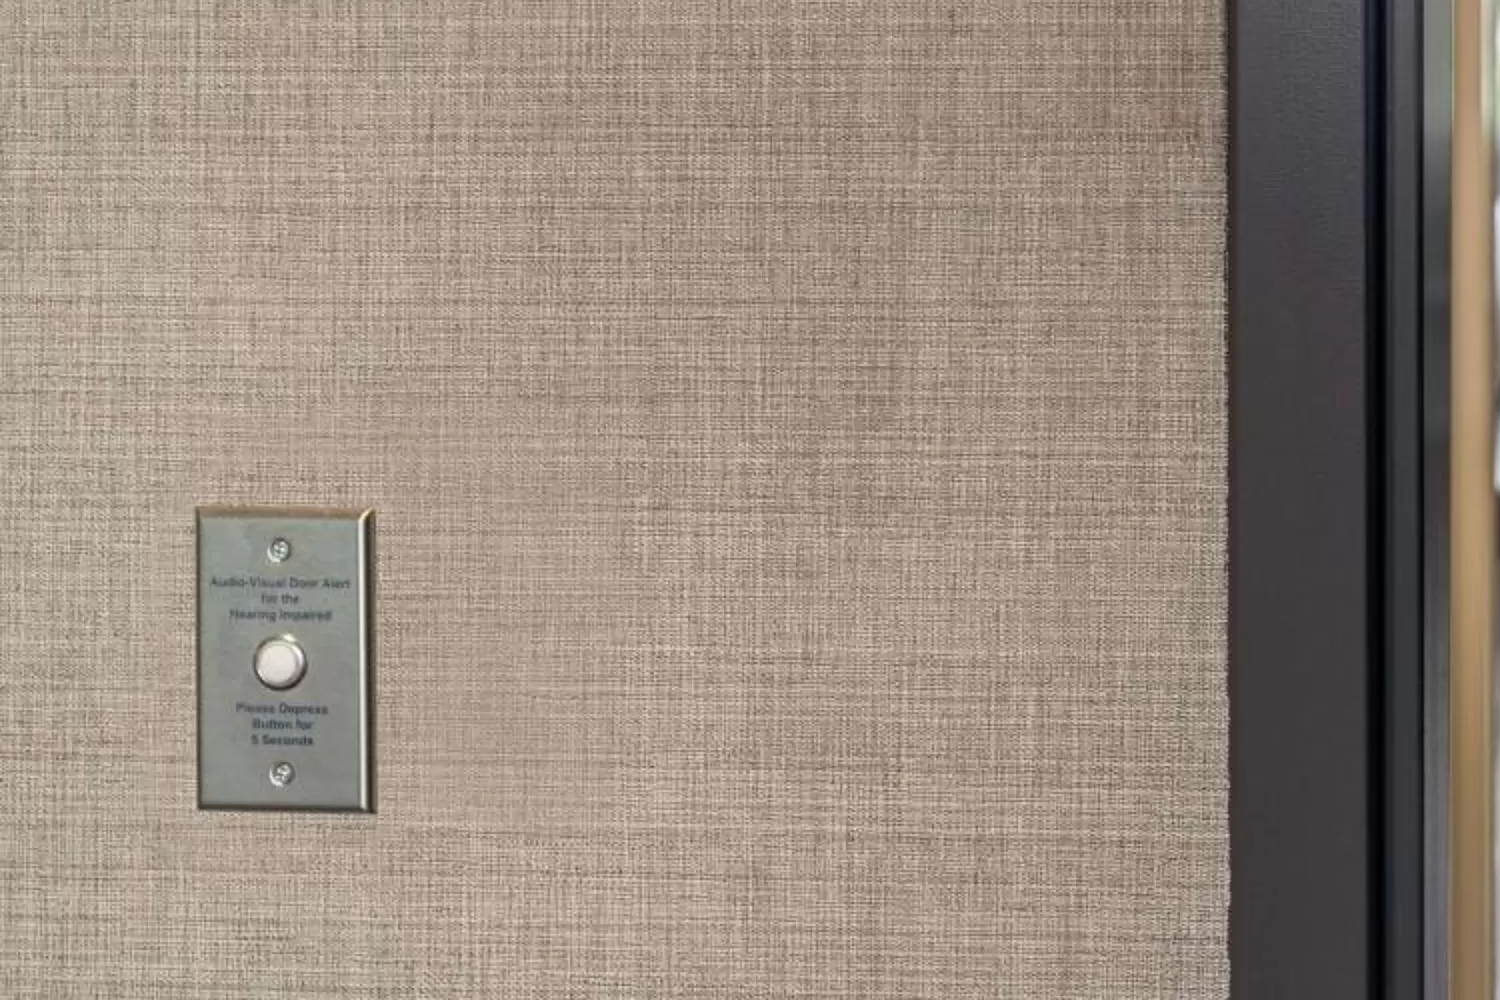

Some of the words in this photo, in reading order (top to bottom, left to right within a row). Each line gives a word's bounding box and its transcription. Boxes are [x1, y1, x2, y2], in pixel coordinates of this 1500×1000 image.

[211, 577, 286, 588] Audio-Visual
[289, 577, 319, 588] Door
[322, 577, 350, 588] Alert
[261, 592, 277, 605] for
[280, 592, 299, 605] the
[229, 609, 277, 622] Hearing
[280, 609, 333, 622] Impaired
[236, 703, 275, 714] Please
[279, 703, 328, 717] Depress
[252, 719, 293, 731] Button
[296, 719, 313, 731] for
[251, 735, 259, 746] 5
[262, 735, 314, 746] Seconds
